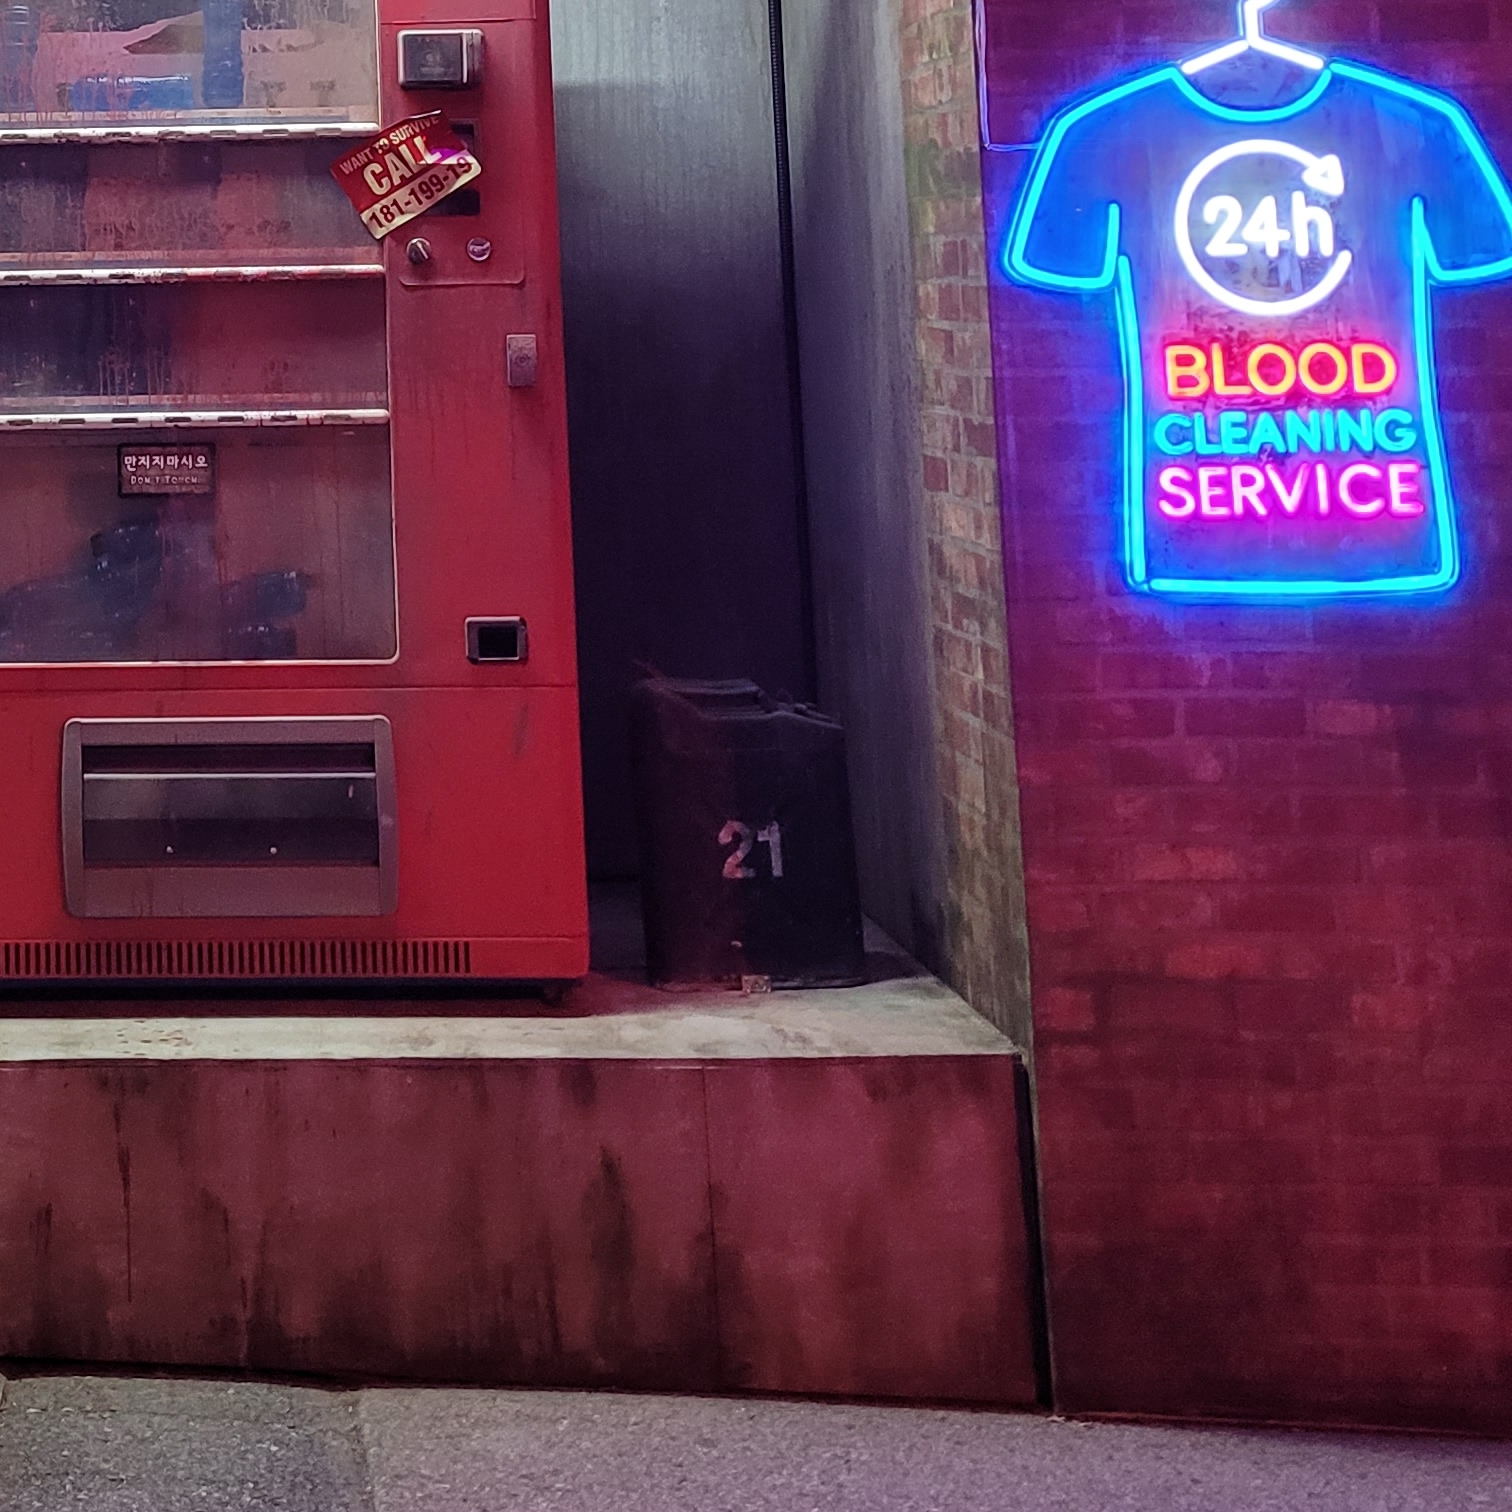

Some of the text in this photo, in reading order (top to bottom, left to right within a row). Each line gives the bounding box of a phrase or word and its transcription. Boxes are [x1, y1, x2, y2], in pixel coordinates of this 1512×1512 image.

[339, 115, 440, 175] WANT TO SURVIVE
[363, 135, 443, 196] CALL
[368, 156, 474, 230] 181-199-19
[1202, 190, 1335, 259] 24h
[1164, 342, 1398, 398] BLOOD
[1153, 407, 1418, 456] CLEANING
[124, 454, 209, 472] 만지지마시오
[1157, 461, 1425, 518] SERVICE
[717, 819, 784, 879] 21
